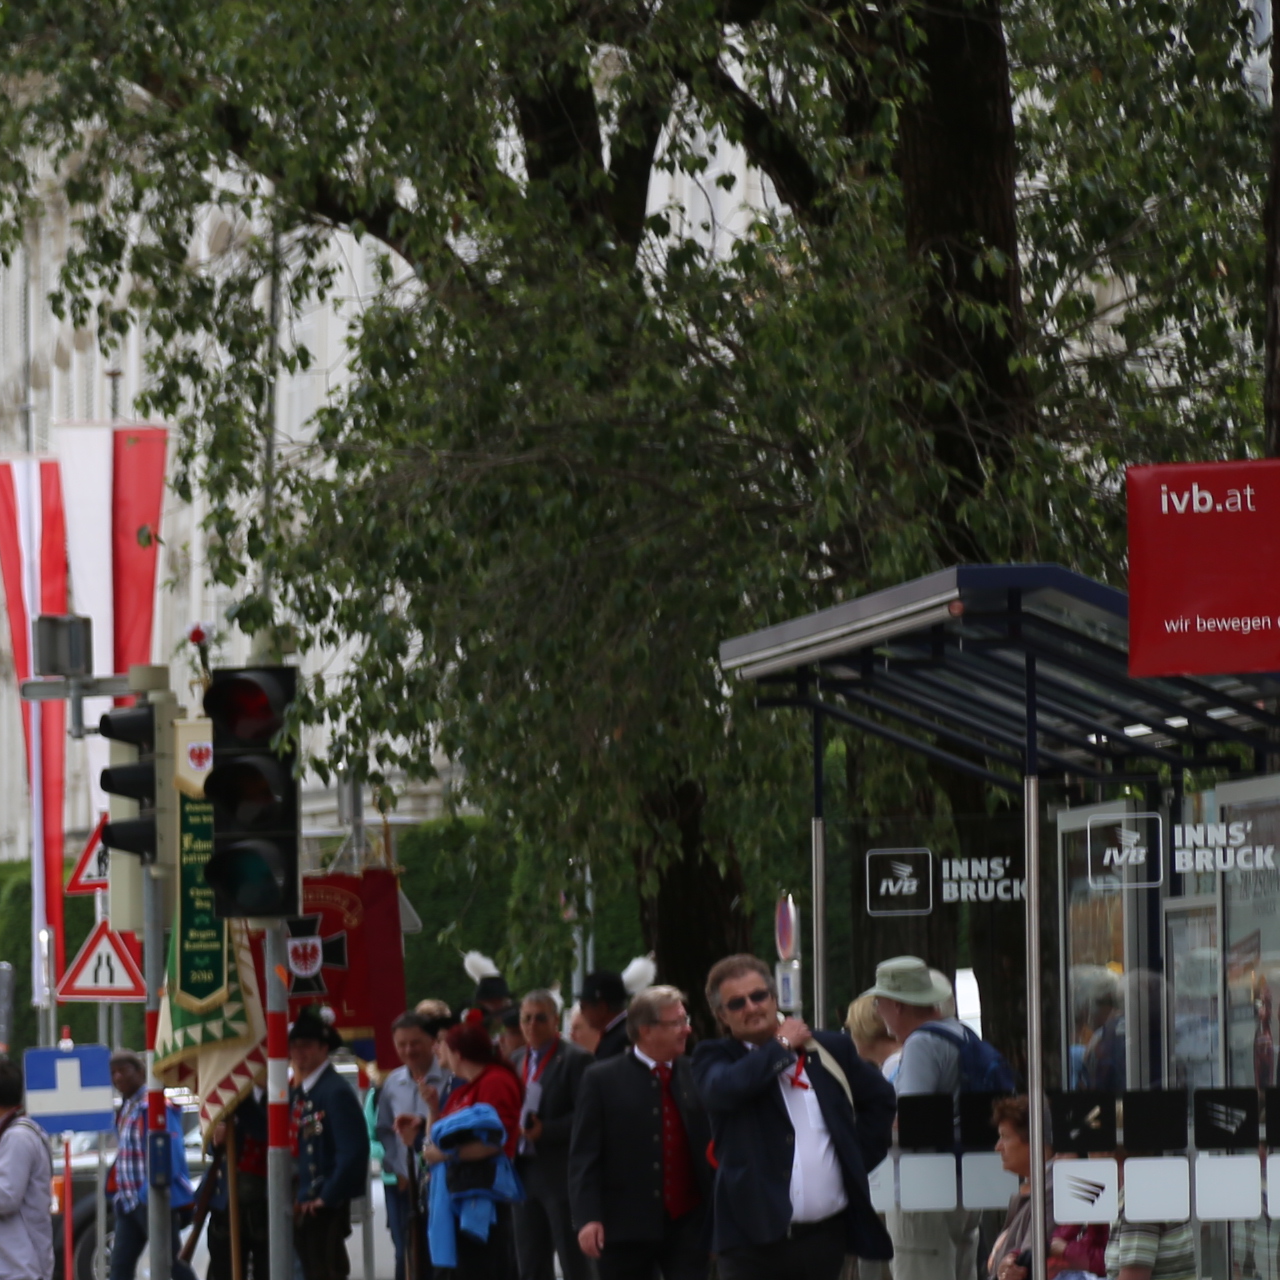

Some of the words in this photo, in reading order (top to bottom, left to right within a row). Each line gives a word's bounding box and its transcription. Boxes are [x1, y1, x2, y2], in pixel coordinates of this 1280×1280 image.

[1160, 482, 1256, 515] ivb.at
[1164, 615, 1190, 633] wir
[1196, 614, 1271, 635] bewegen
[1103, 846, 1147, 867] IVB
[1174, 845, 1276, 873] BRUCK
[879, 878, 919, 896] IVB
[942, 878, 1028, 904] BRUCK
